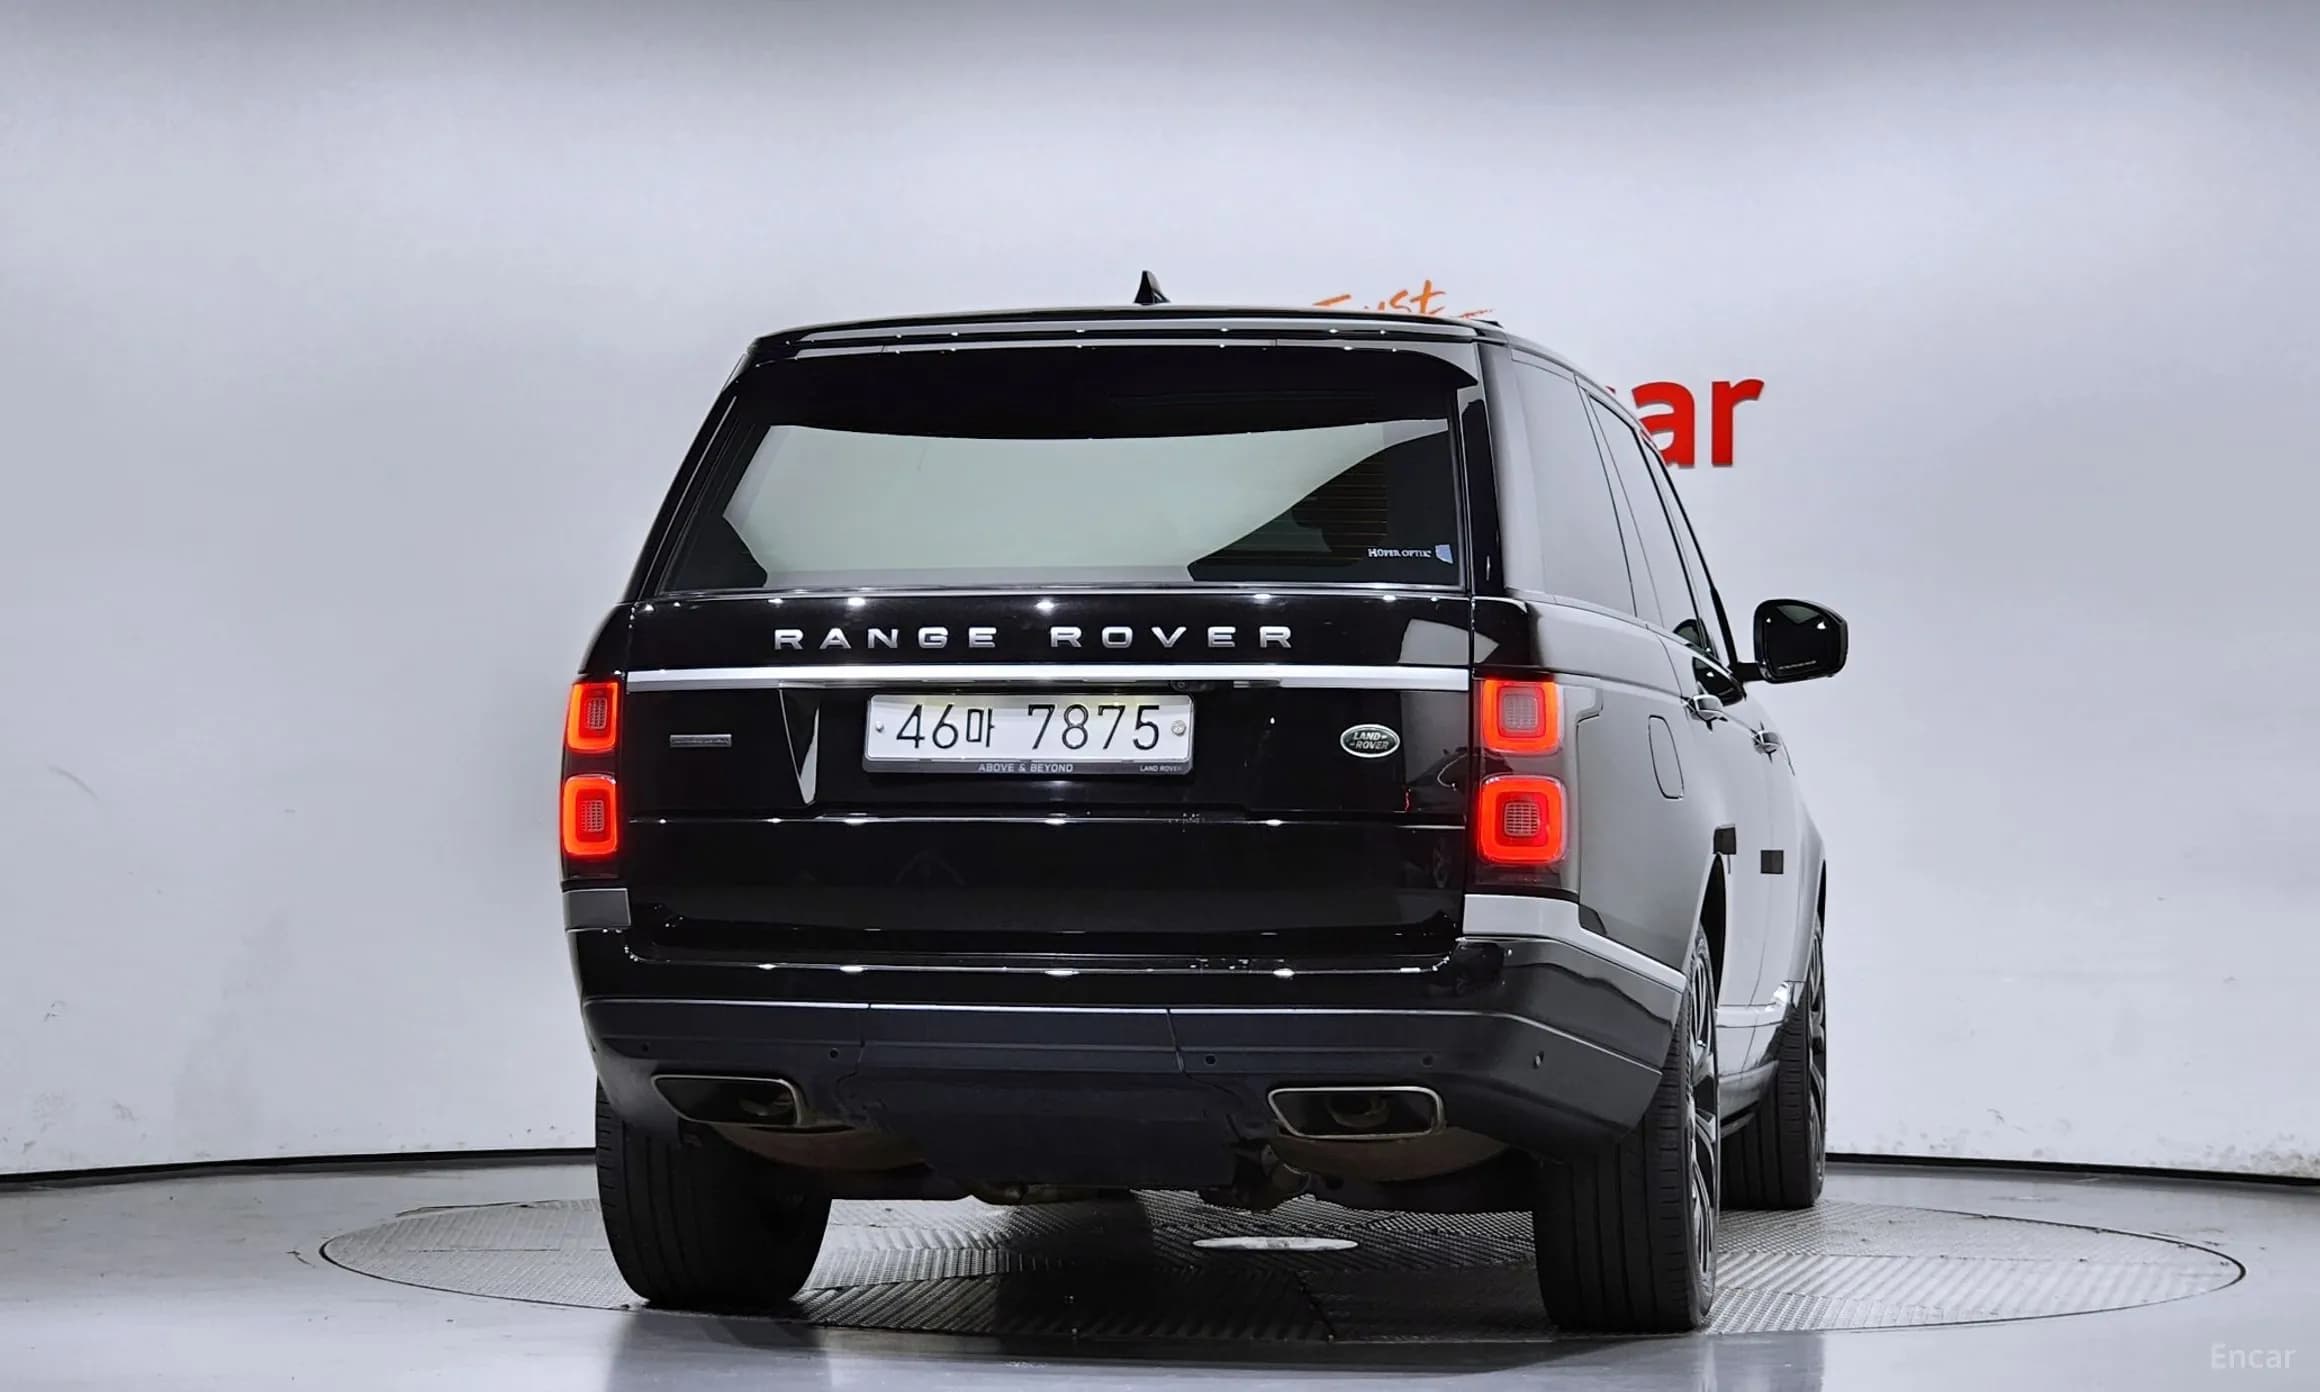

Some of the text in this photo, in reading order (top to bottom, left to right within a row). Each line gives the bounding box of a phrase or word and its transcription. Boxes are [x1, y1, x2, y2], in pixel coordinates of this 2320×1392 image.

[774, 626, 1292, 650] RANGE ROVER
[896, 704, 1161, 750] 46마 7875
[1353, 732, 1380, 740] LAND
[1355, 741, 1389, 750] ROVER
[978, 763, 1073, 773] ABOVE & BEYOND
